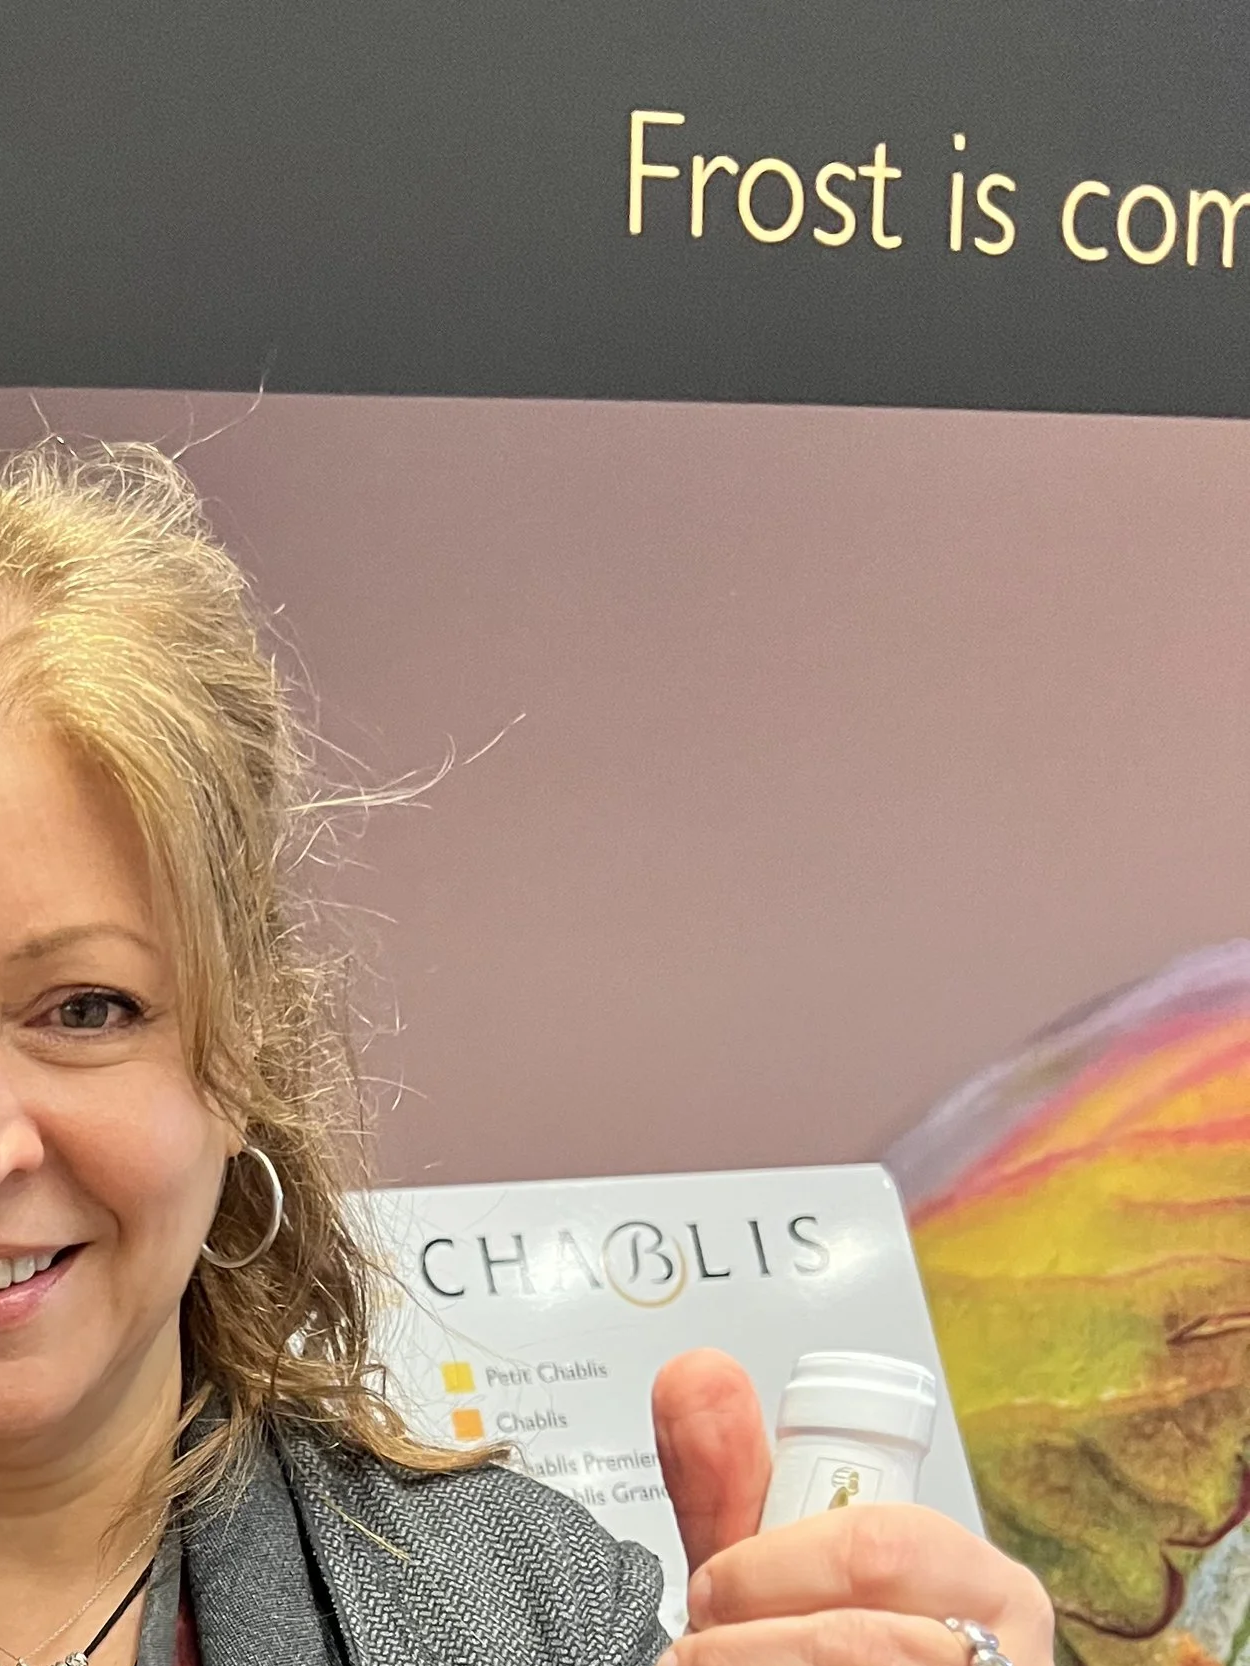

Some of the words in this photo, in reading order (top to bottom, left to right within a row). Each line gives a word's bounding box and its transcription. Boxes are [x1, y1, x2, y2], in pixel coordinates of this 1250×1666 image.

[628, 109, 903, 251] Frost
[949, 132, 1017, 256] is
[420, 1214, 831, 1306] CHABLIS
[486, 1365, 532, 1388] Petit
[537, 1361, 609, 1384] Chablis
[497, 1410, 568, 1433] Chablis
[529, 1453, 579, 1478] ablis
